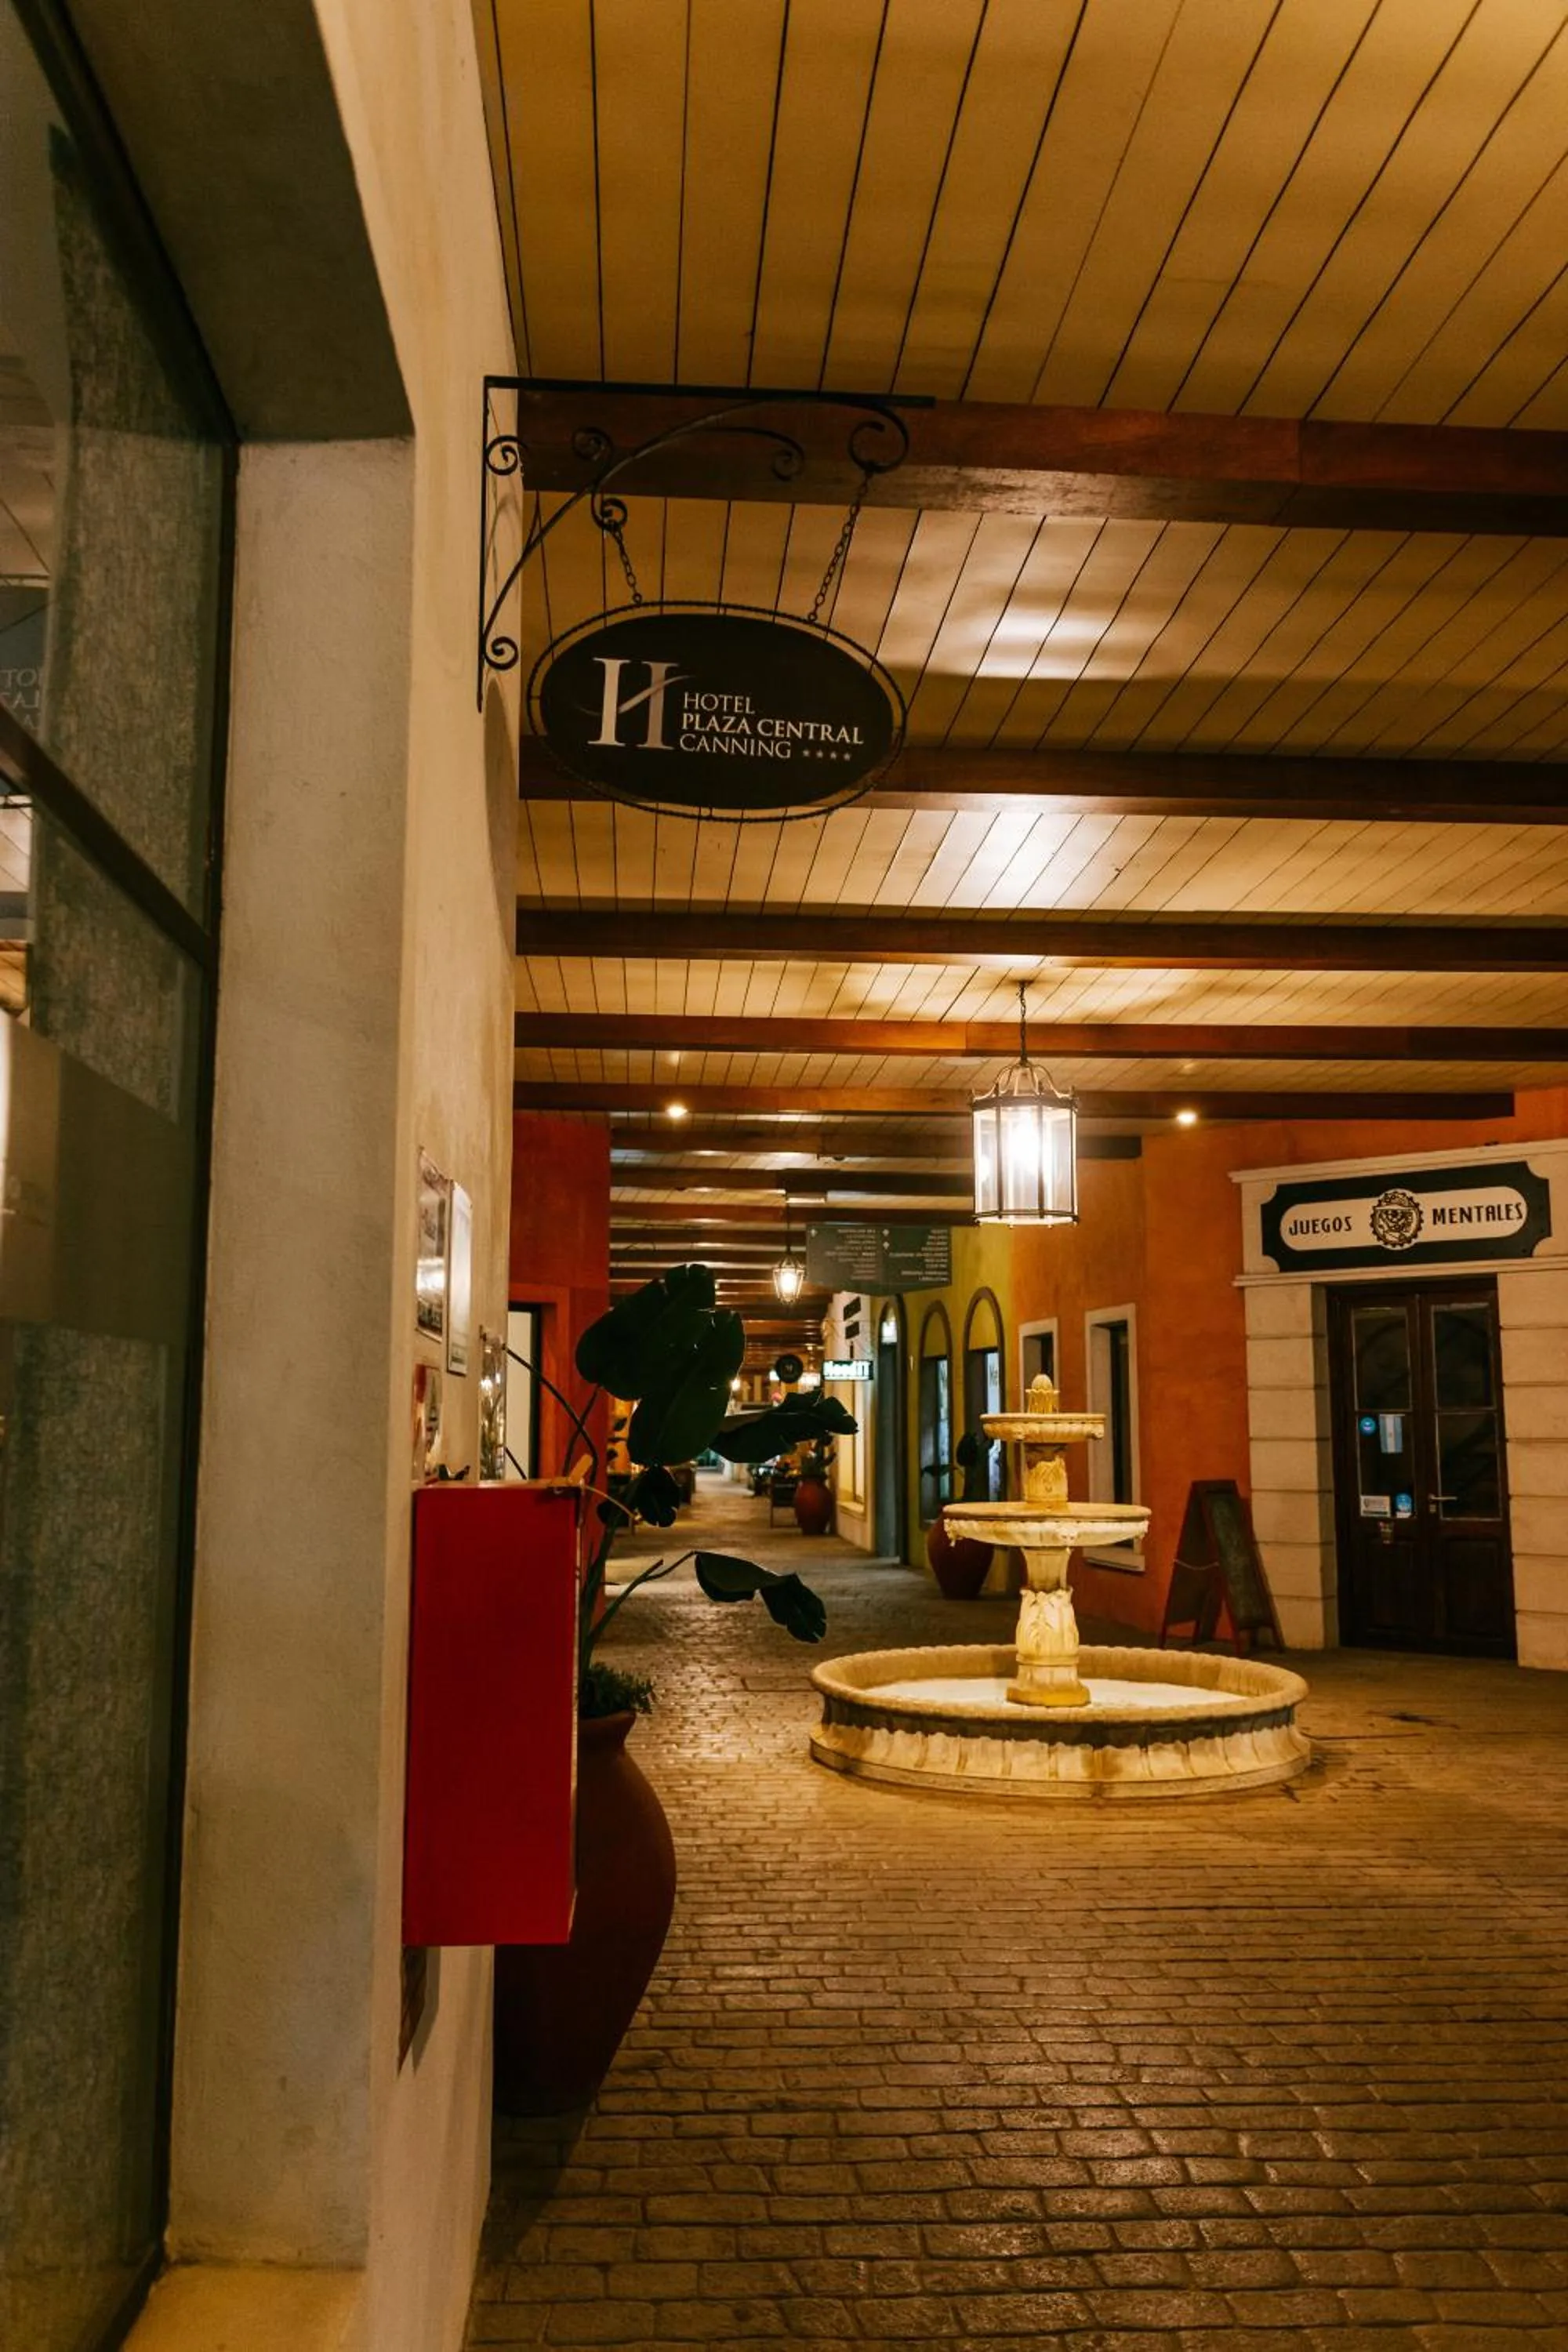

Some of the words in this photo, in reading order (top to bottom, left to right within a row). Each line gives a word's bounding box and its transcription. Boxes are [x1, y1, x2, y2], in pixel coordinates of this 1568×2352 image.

[587, 657, 680, 750] H
[684, 692, 756, 715] HOTEL
[681, 713, 750, 735] PLAZA
[757, 718, 864, 745] CENTRAL
[680, 733, 792, 760] CANNING
[1289, 1216, 1352, 1236] JUEGOS
[1432, 1202, 1523, 1225] MENTALES
